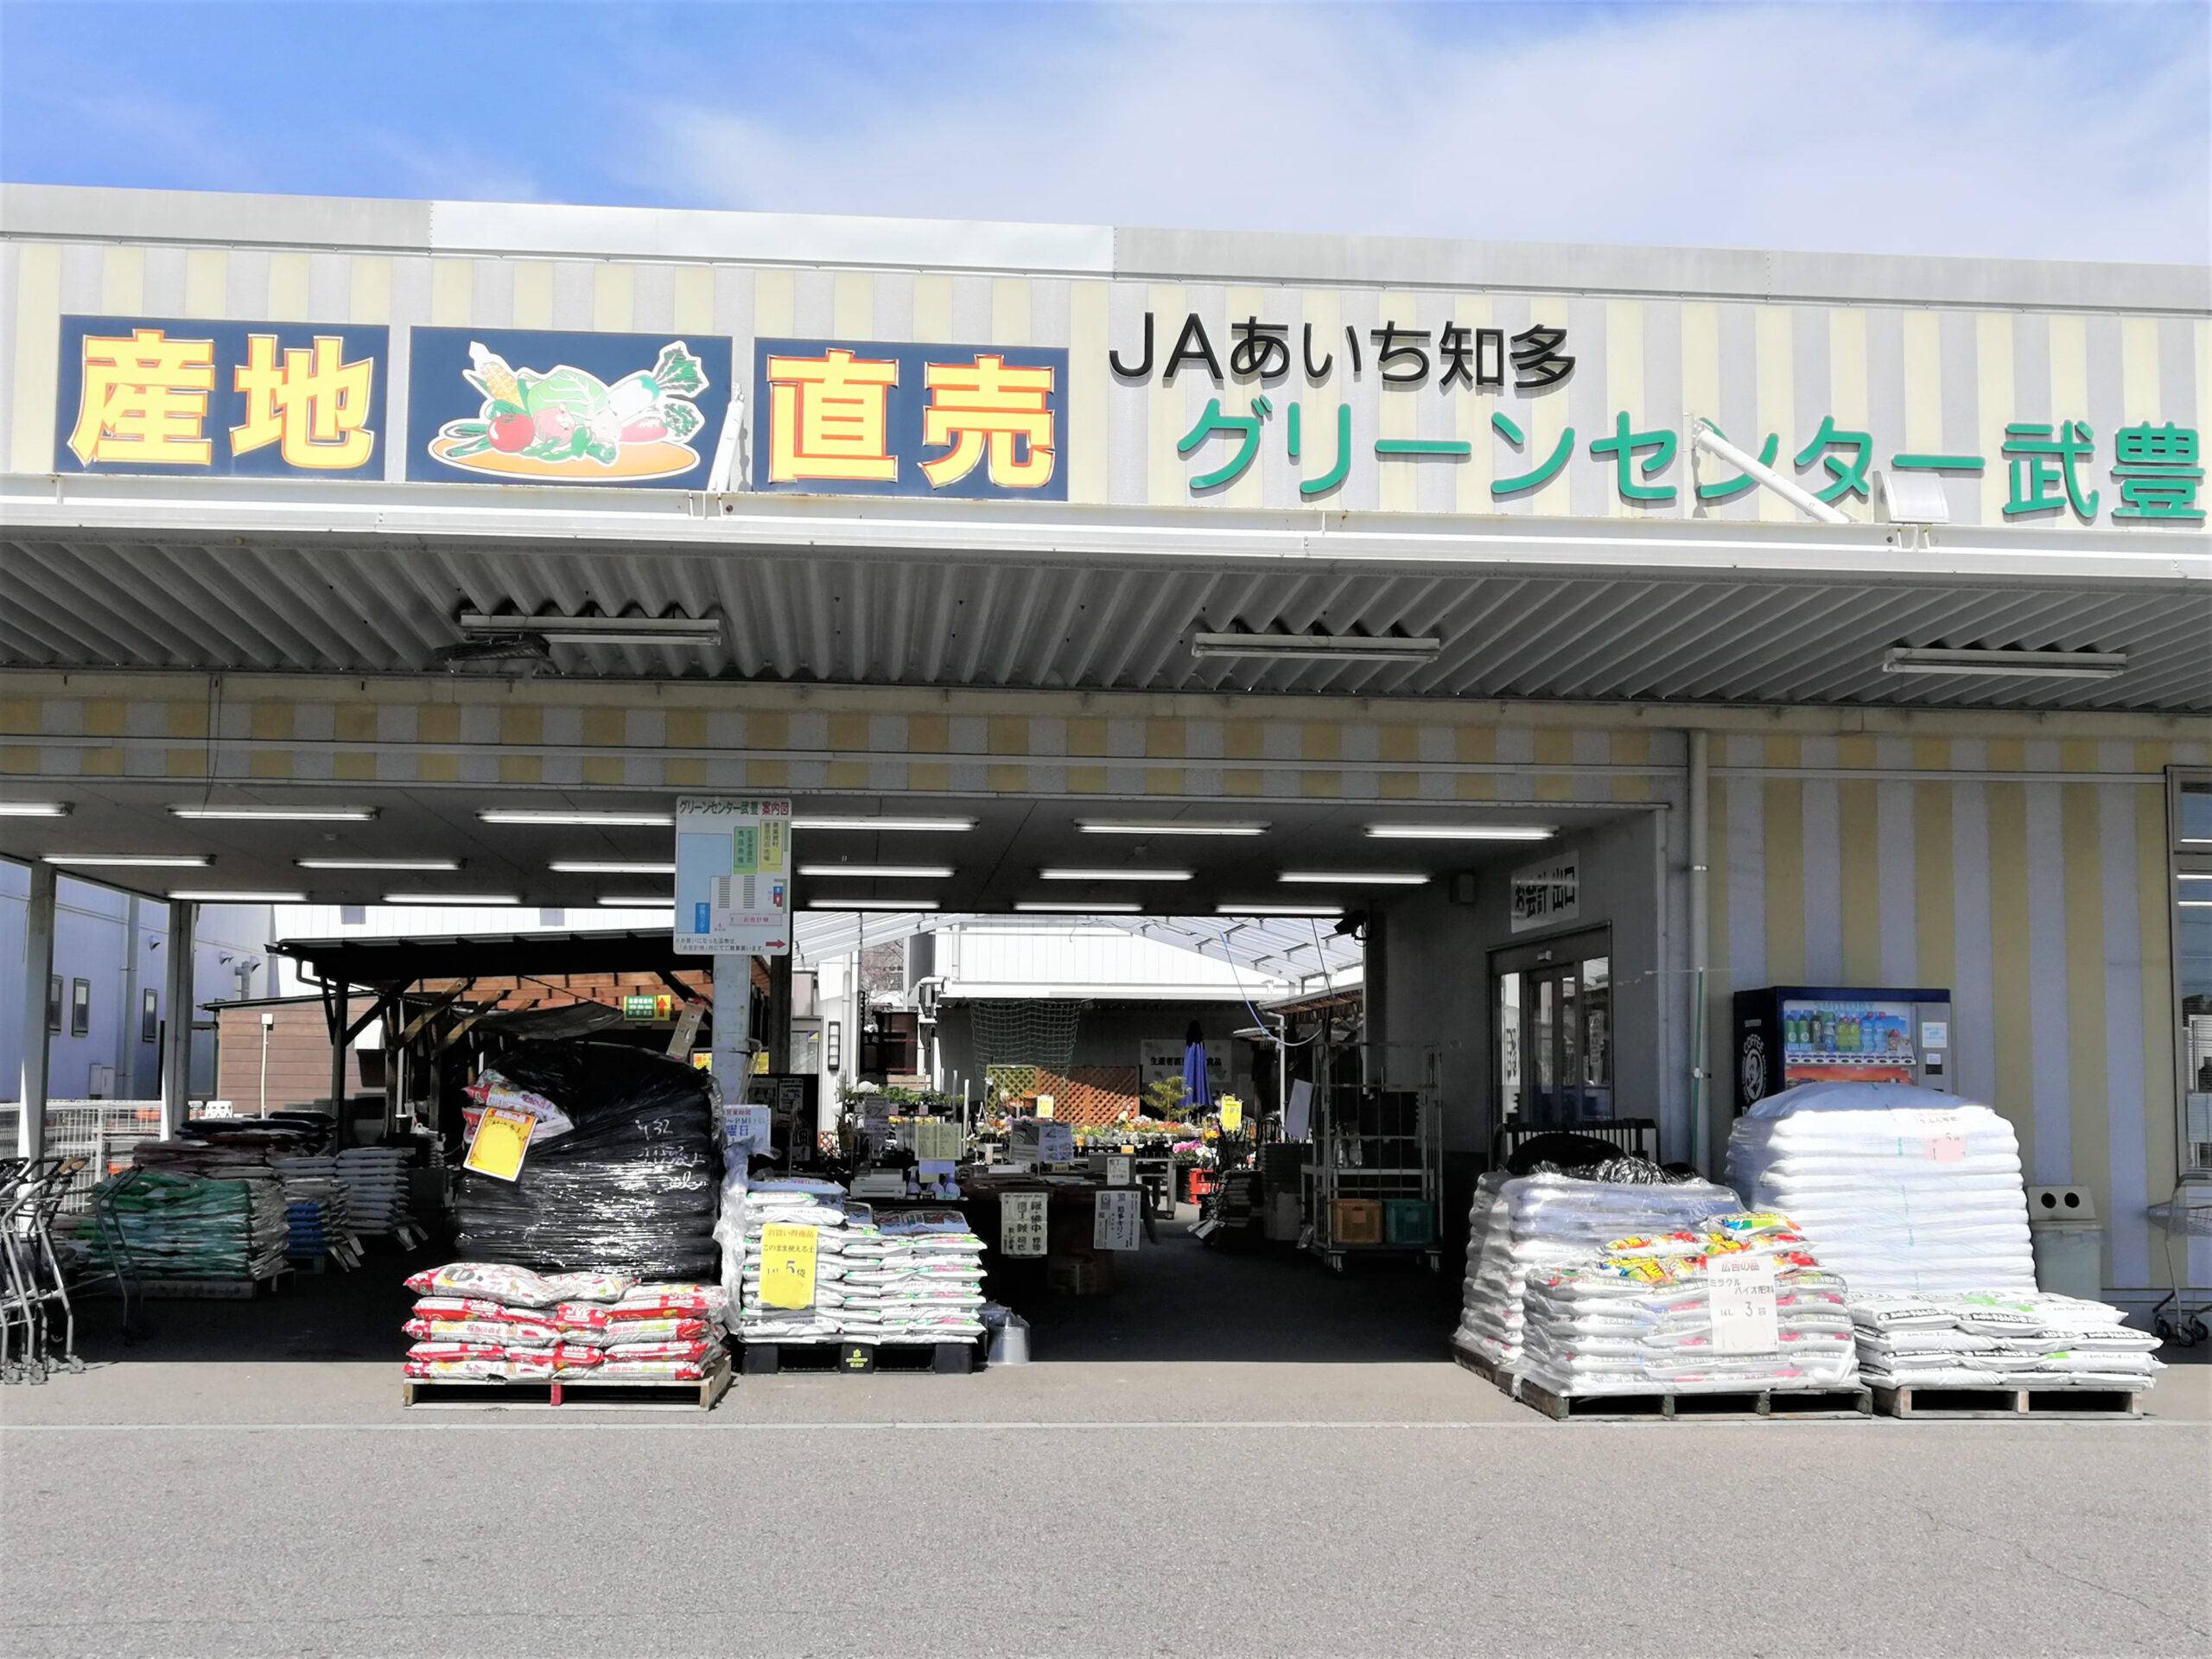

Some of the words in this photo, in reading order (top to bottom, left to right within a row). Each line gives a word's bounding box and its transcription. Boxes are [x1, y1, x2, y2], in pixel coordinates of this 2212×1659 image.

[1109, 311, 1577, 391] JAあいち知多
[67, 328, 375, 469] 産地
[766, 347, 1056, 490] 直売
[762, 801, 789, 816] 案内図
[1744, 1033, 1765, 1054] COFFEE
[1709, 1279, 1741, 1287] ミラクル
